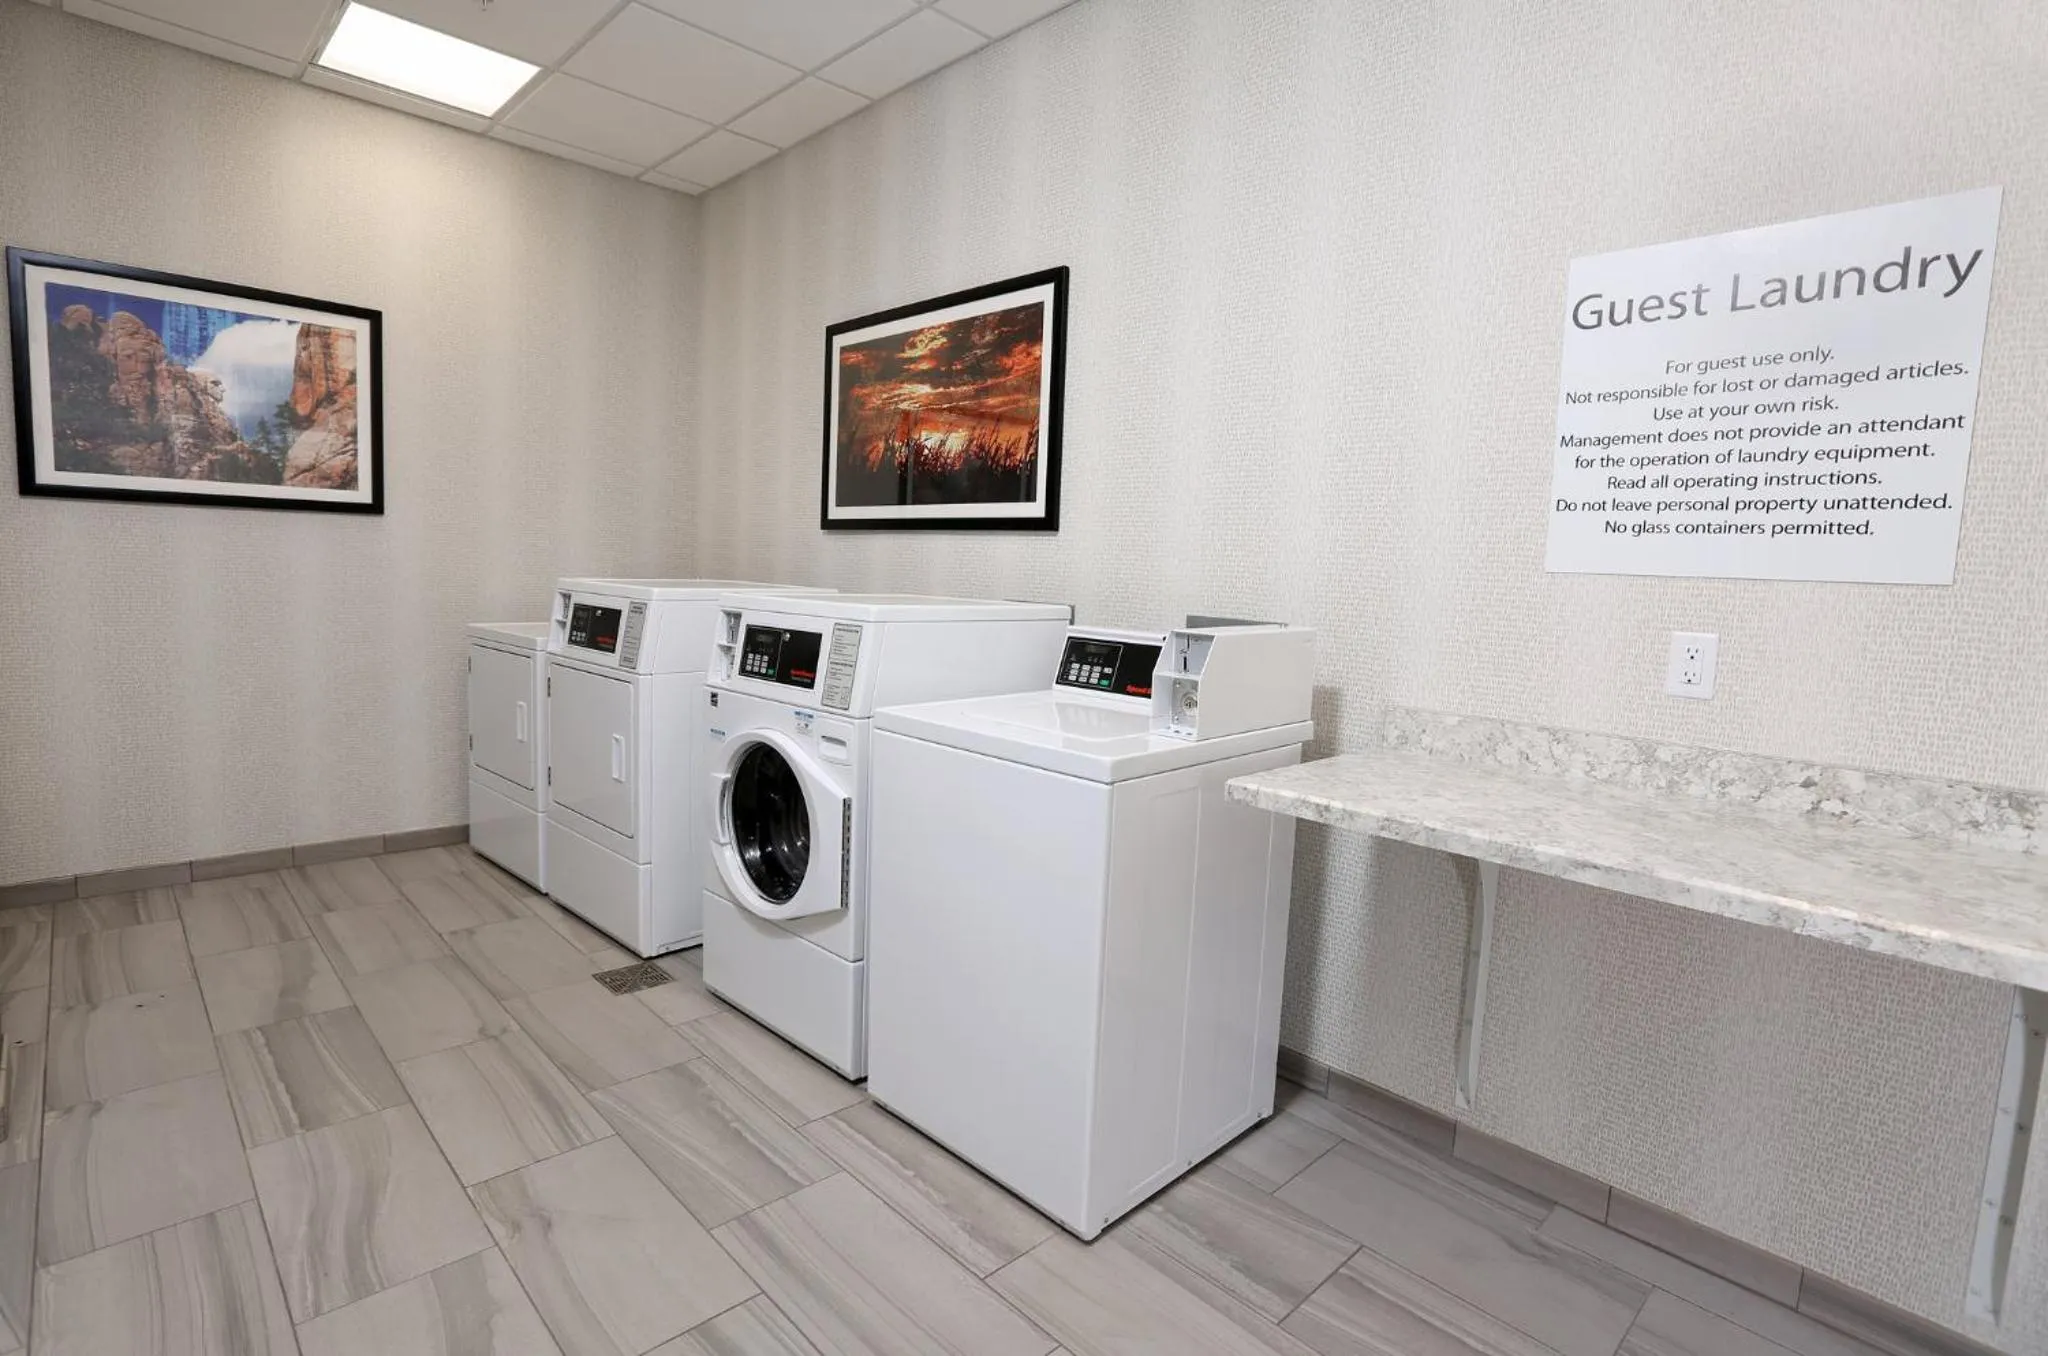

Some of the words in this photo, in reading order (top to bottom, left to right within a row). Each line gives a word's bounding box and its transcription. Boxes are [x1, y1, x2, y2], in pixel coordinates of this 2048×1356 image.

[1572, 284, 1710, 330] Guest
[1730, 245, 1984, 312] Laundry
[1665, 360, 1693, 375] For
[1697, 355, 1747, 375] guest
[1752, 353, 1784, 367] use
[1789, 345, 1834, 365] only.
[1566, 391, 1593, 405] Not
[1597, 382, 1688, 405] responsible
[1693, 380, 1718, 396] for
[1722, 378, 1754, 393] lost
[1759, 378, 1779, 390] or
[1784, 365, 1880, 388] damaged
[1886, 360, 1969, 381] articles.
[1653, 407, 1683, 421] Use
[1687, 406, 1704, 419] at
[1709, 404, 1750, 422] your
[1754, 401, 1796, 414] own
[1802, 394, 1839, 412] risk.
[1560, 431, 1664, 450] Management
[1667, 428, 1708, 443] does
[1714, 427, 1744, 441] not
[1749, 420, 1822, 443] provide
[1827, 423, 1852, 435] an
[1858, 414, 1966, 434] attendant
[1575, 454, 1596, 469] for
[1600, 454, 1625, 468] the
[1629, 451, 1709, 470] operation
[1715, 448, 1735, 464] of
[1738, 446, 1810, 466] laundry
[1814, 443, 1935, 464] equipment.
[1607, 474, 1646, 490] Read
[1650, 474, 1669, 489] all
[1673, 473, 1758, 492] operating
[1764, 470, 1882, 487] instructions.
[1556, 498, 1578, 512] Do
[1581, 500, 1608, 512] not
[1611, 497, 1652, 512] leave
[1656, 496, 1730, 515] personal
[1734, 497, 1818, 515] property
[1823, 492, 1952, 511] unattended.
[1605, 520, 1627, 534] No
[1631, 519, 1670, 538] glass
[1675, 520, 1766, 535] containers
[1771, 519, 1874, 539] permitted.
